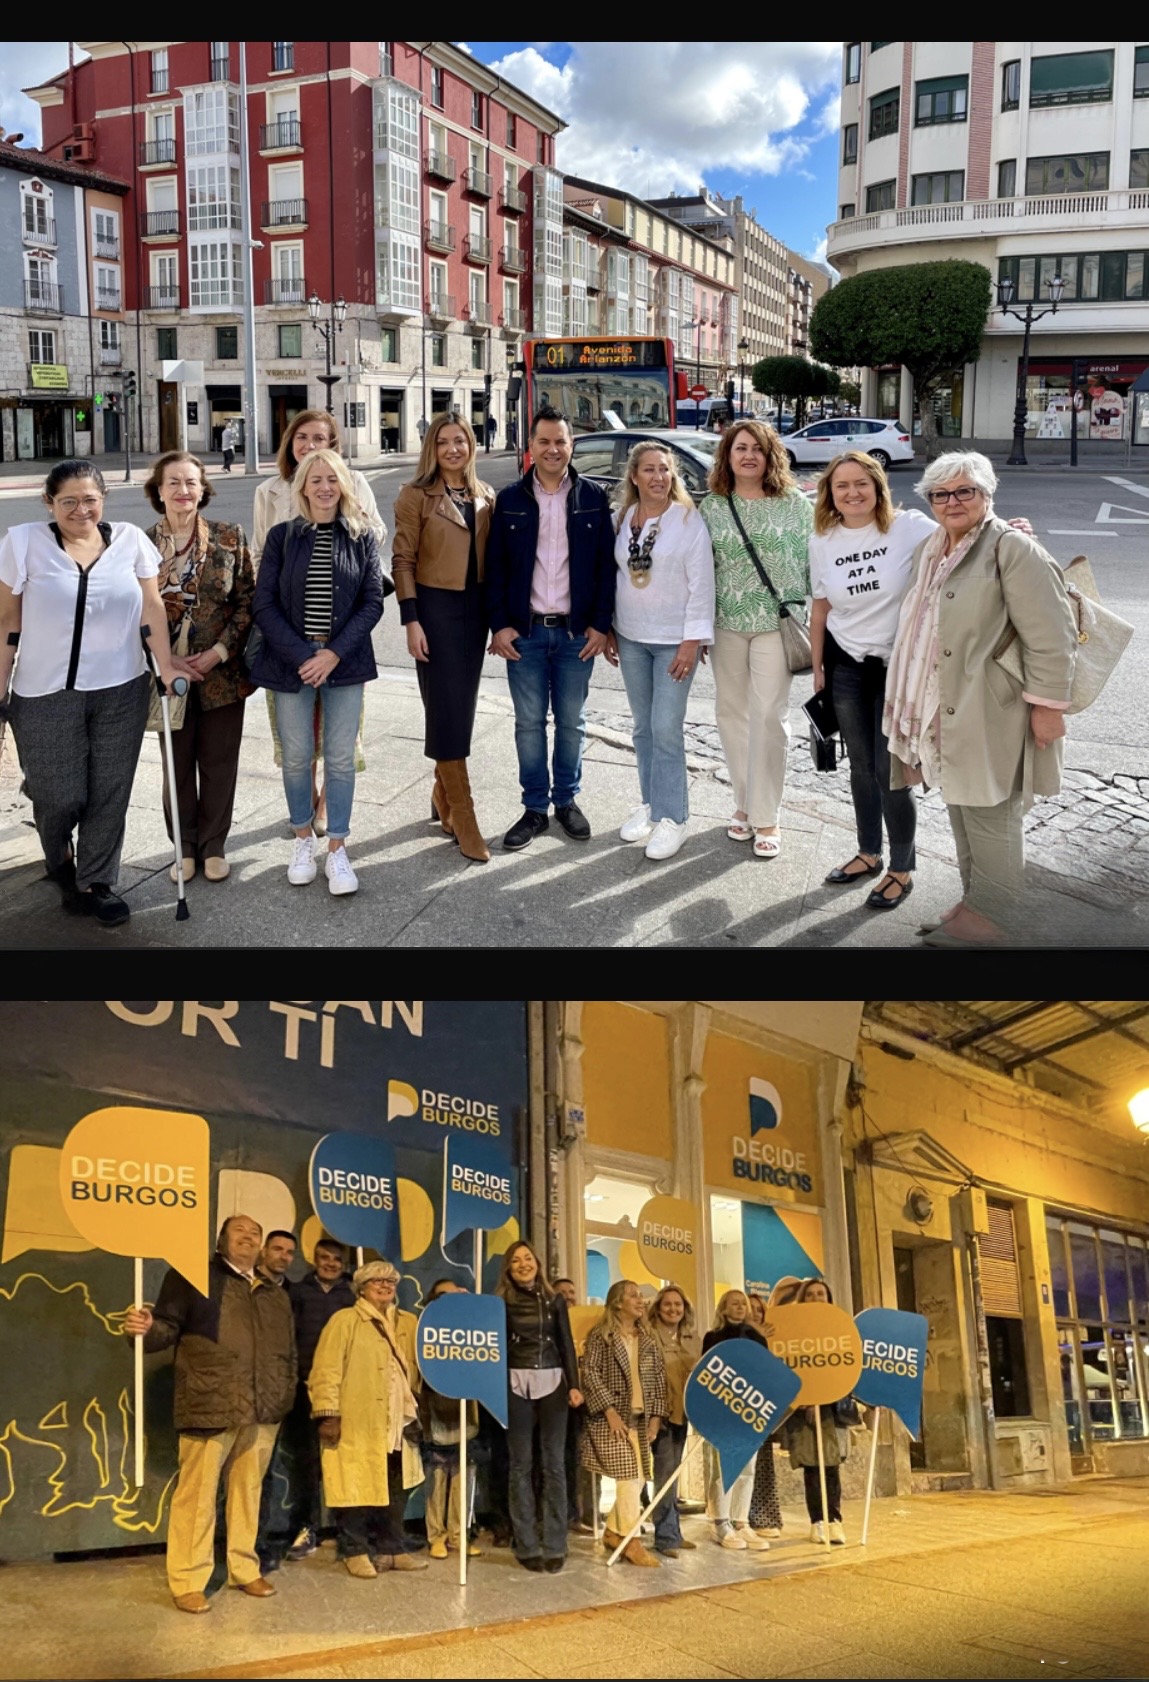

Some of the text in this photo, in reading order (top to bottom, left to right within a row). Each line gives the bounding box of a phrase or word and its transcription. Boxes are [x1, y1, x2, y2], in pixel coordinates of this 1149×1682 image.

[547, 346, 564, 365] 01
[583, 345, 633, 355] Avenida
[1089, 364, 1120, 372] arenal
[835, 546, 888, 566] ONE DAY
[848, 565, 876, 579] AT A
[846, 580, 880, 596] TIME
[269, 1000, 335, 1068] TI
[421, 1089, 500, 1121] DECIDE
[421, 1108, 501, 1137] BURGOS
[732, 1135, 807, 1173] DECIDE
[70, 1155, 196, 1188] DECIDE
[318, 1167, 392, 1195] DECIDE
[452, 1164, 511, 1193] DECIDE
[732, 1157, 813, 1194] BURGOS
[70, 1180, 198, 1209] BURGOS
[319, 1187, 394, 1212] BURGOS
[451, 1180, 512, 1206] BURGOS
[643, 1220, 693, 1244] DECIDE
[643, 1234, 693, 1256] BURGOS
[423, 1327, 499, 1347] DECIDE
[772, 1335, 853, 1356] DECIDE
[422, 1344, 501, 1363] BURGOS
[778, 1351, 856, 1370] URGOS
[863, 1339, 919, 1364] ECIDE
[862, 1355, 918, 1378] URGOS
[706, 1355, 778, 1421] DECIDE
[695, 1368, 769, 1434] BURGOS
